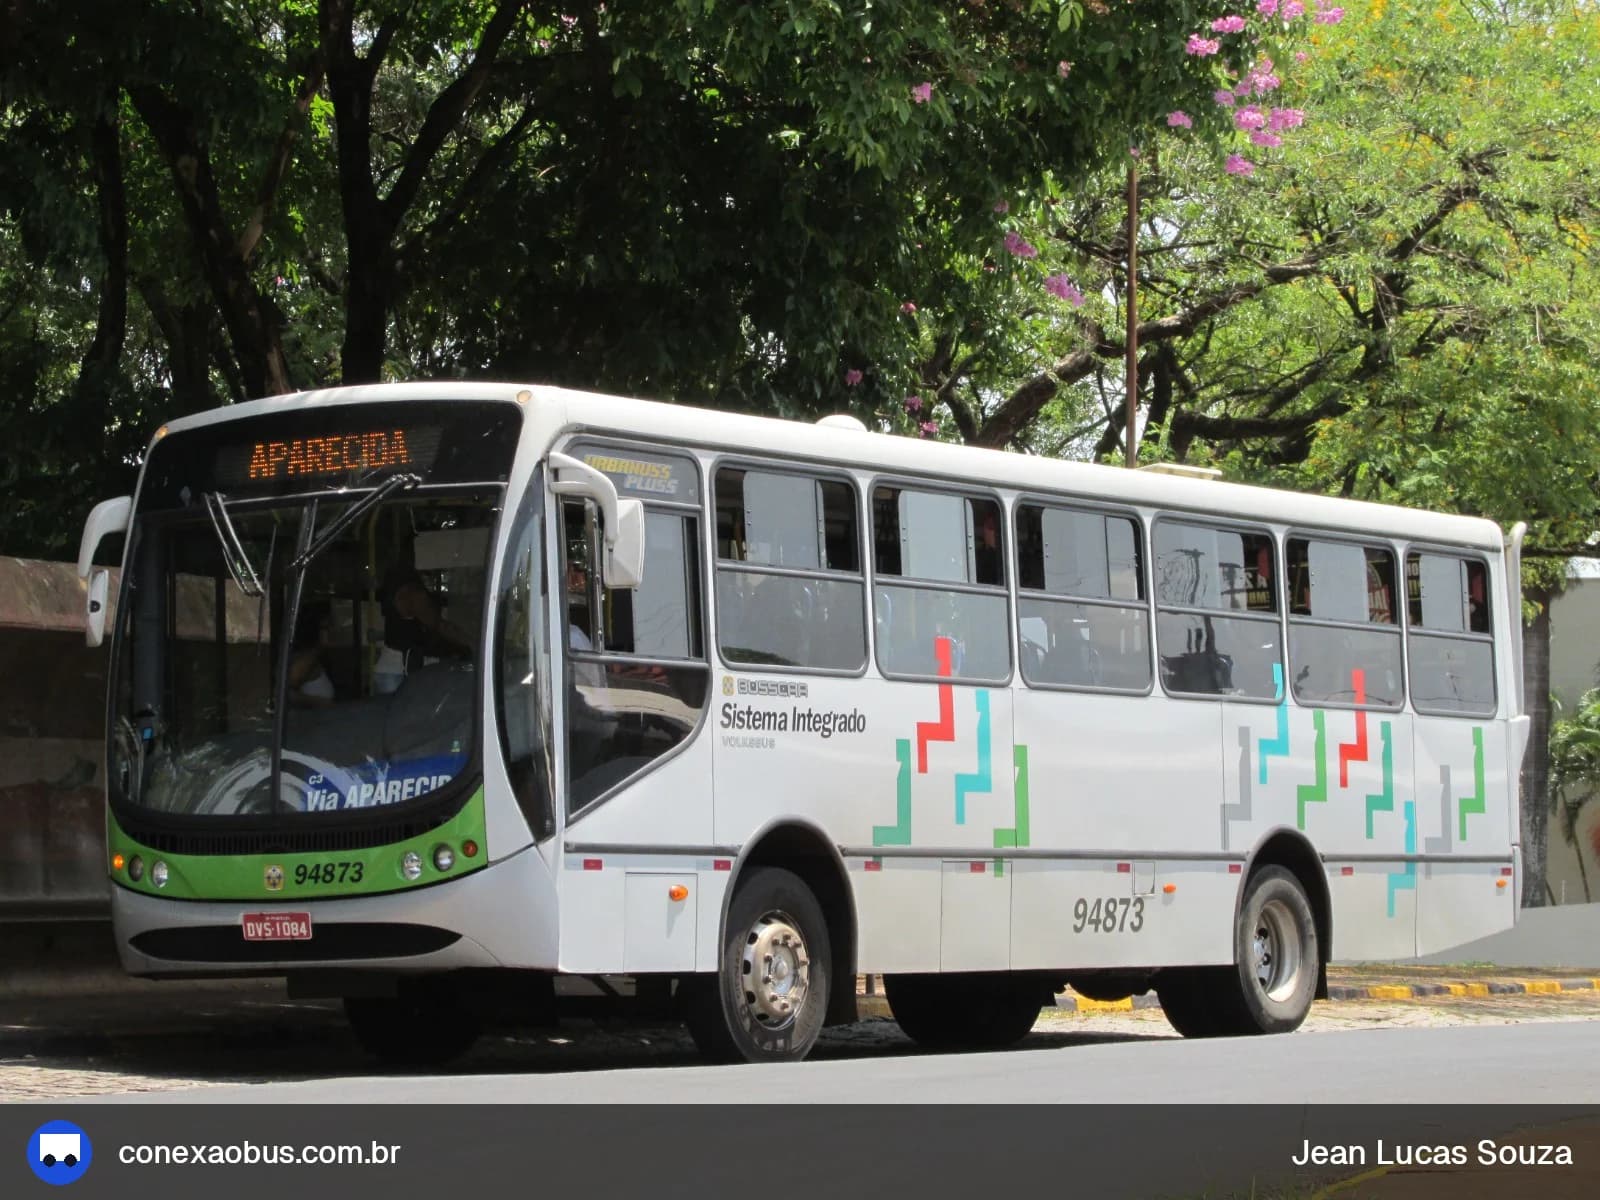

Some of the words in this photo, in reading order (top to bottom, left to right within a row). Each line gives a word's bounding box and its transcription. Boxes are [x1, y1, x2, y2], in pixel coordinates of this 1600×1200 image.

[249, 431, 408, 478] APARECIDA
[737, 678, 809, 698] BUSSCAR
[720, 702, 788, 732] Sistema
[791, 706, 866, 739] Integrado
[308, 774, 324, 785] C3
[306, 790, 339, 812] Via
[294, 861, 364, 885] 94873
[1073, 897, 1145, 933] 94873
